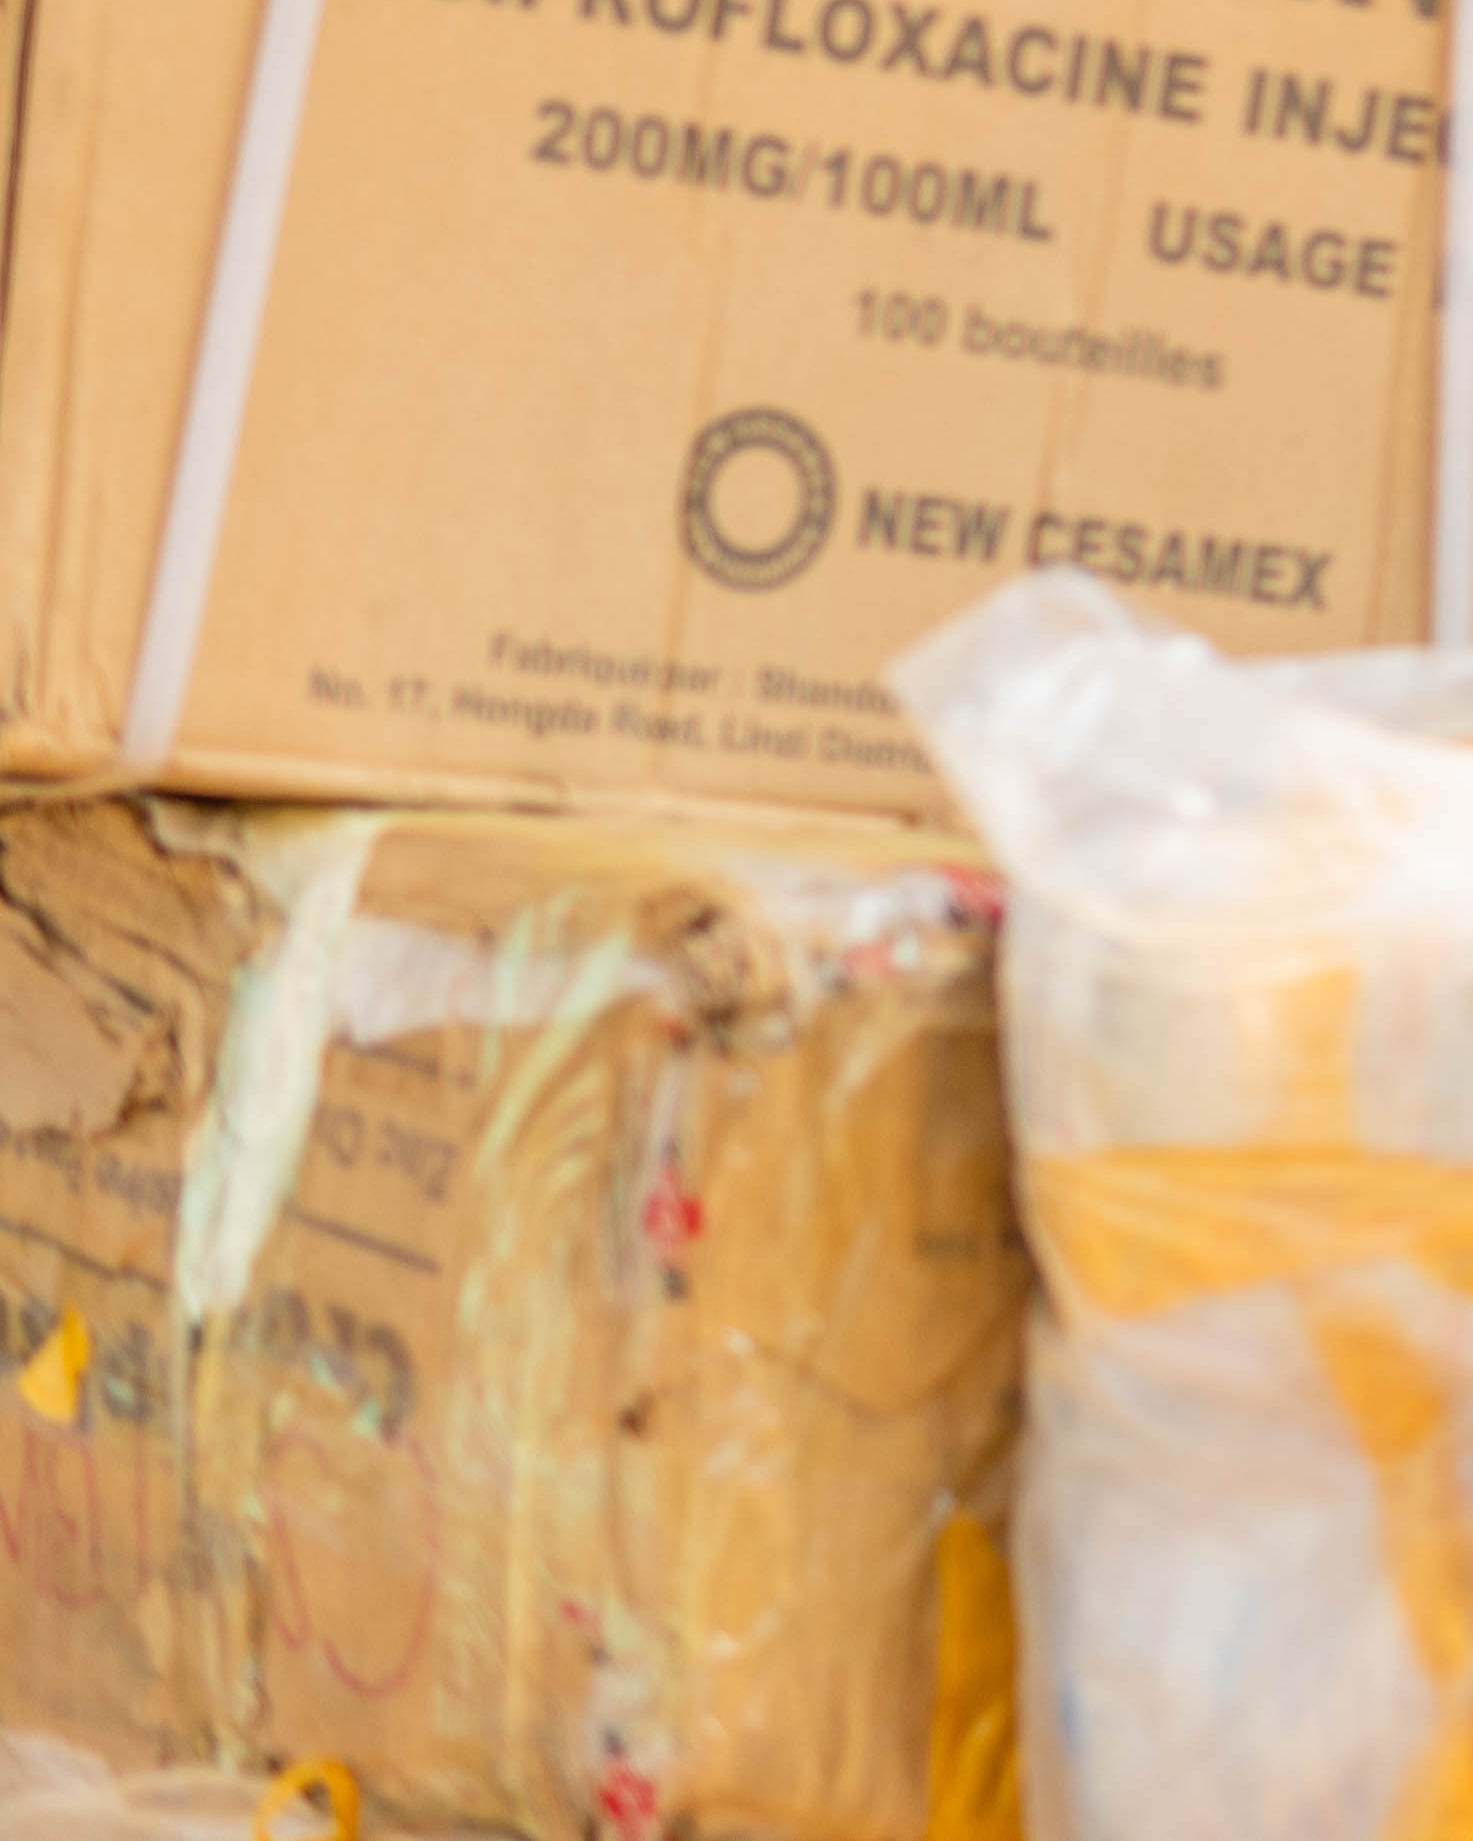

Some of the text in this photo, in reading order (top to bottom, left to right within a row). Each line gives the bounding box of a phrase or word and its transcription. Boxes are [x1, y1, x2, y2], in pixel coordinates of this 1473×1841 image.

[530, 98, 1057, 244] 200MG/100ML
[1147, 199, 1398, 300] USAGE
[857, 486, 1008, 566] NEW
[1024, 510, 1334, 613] CESAMEX
